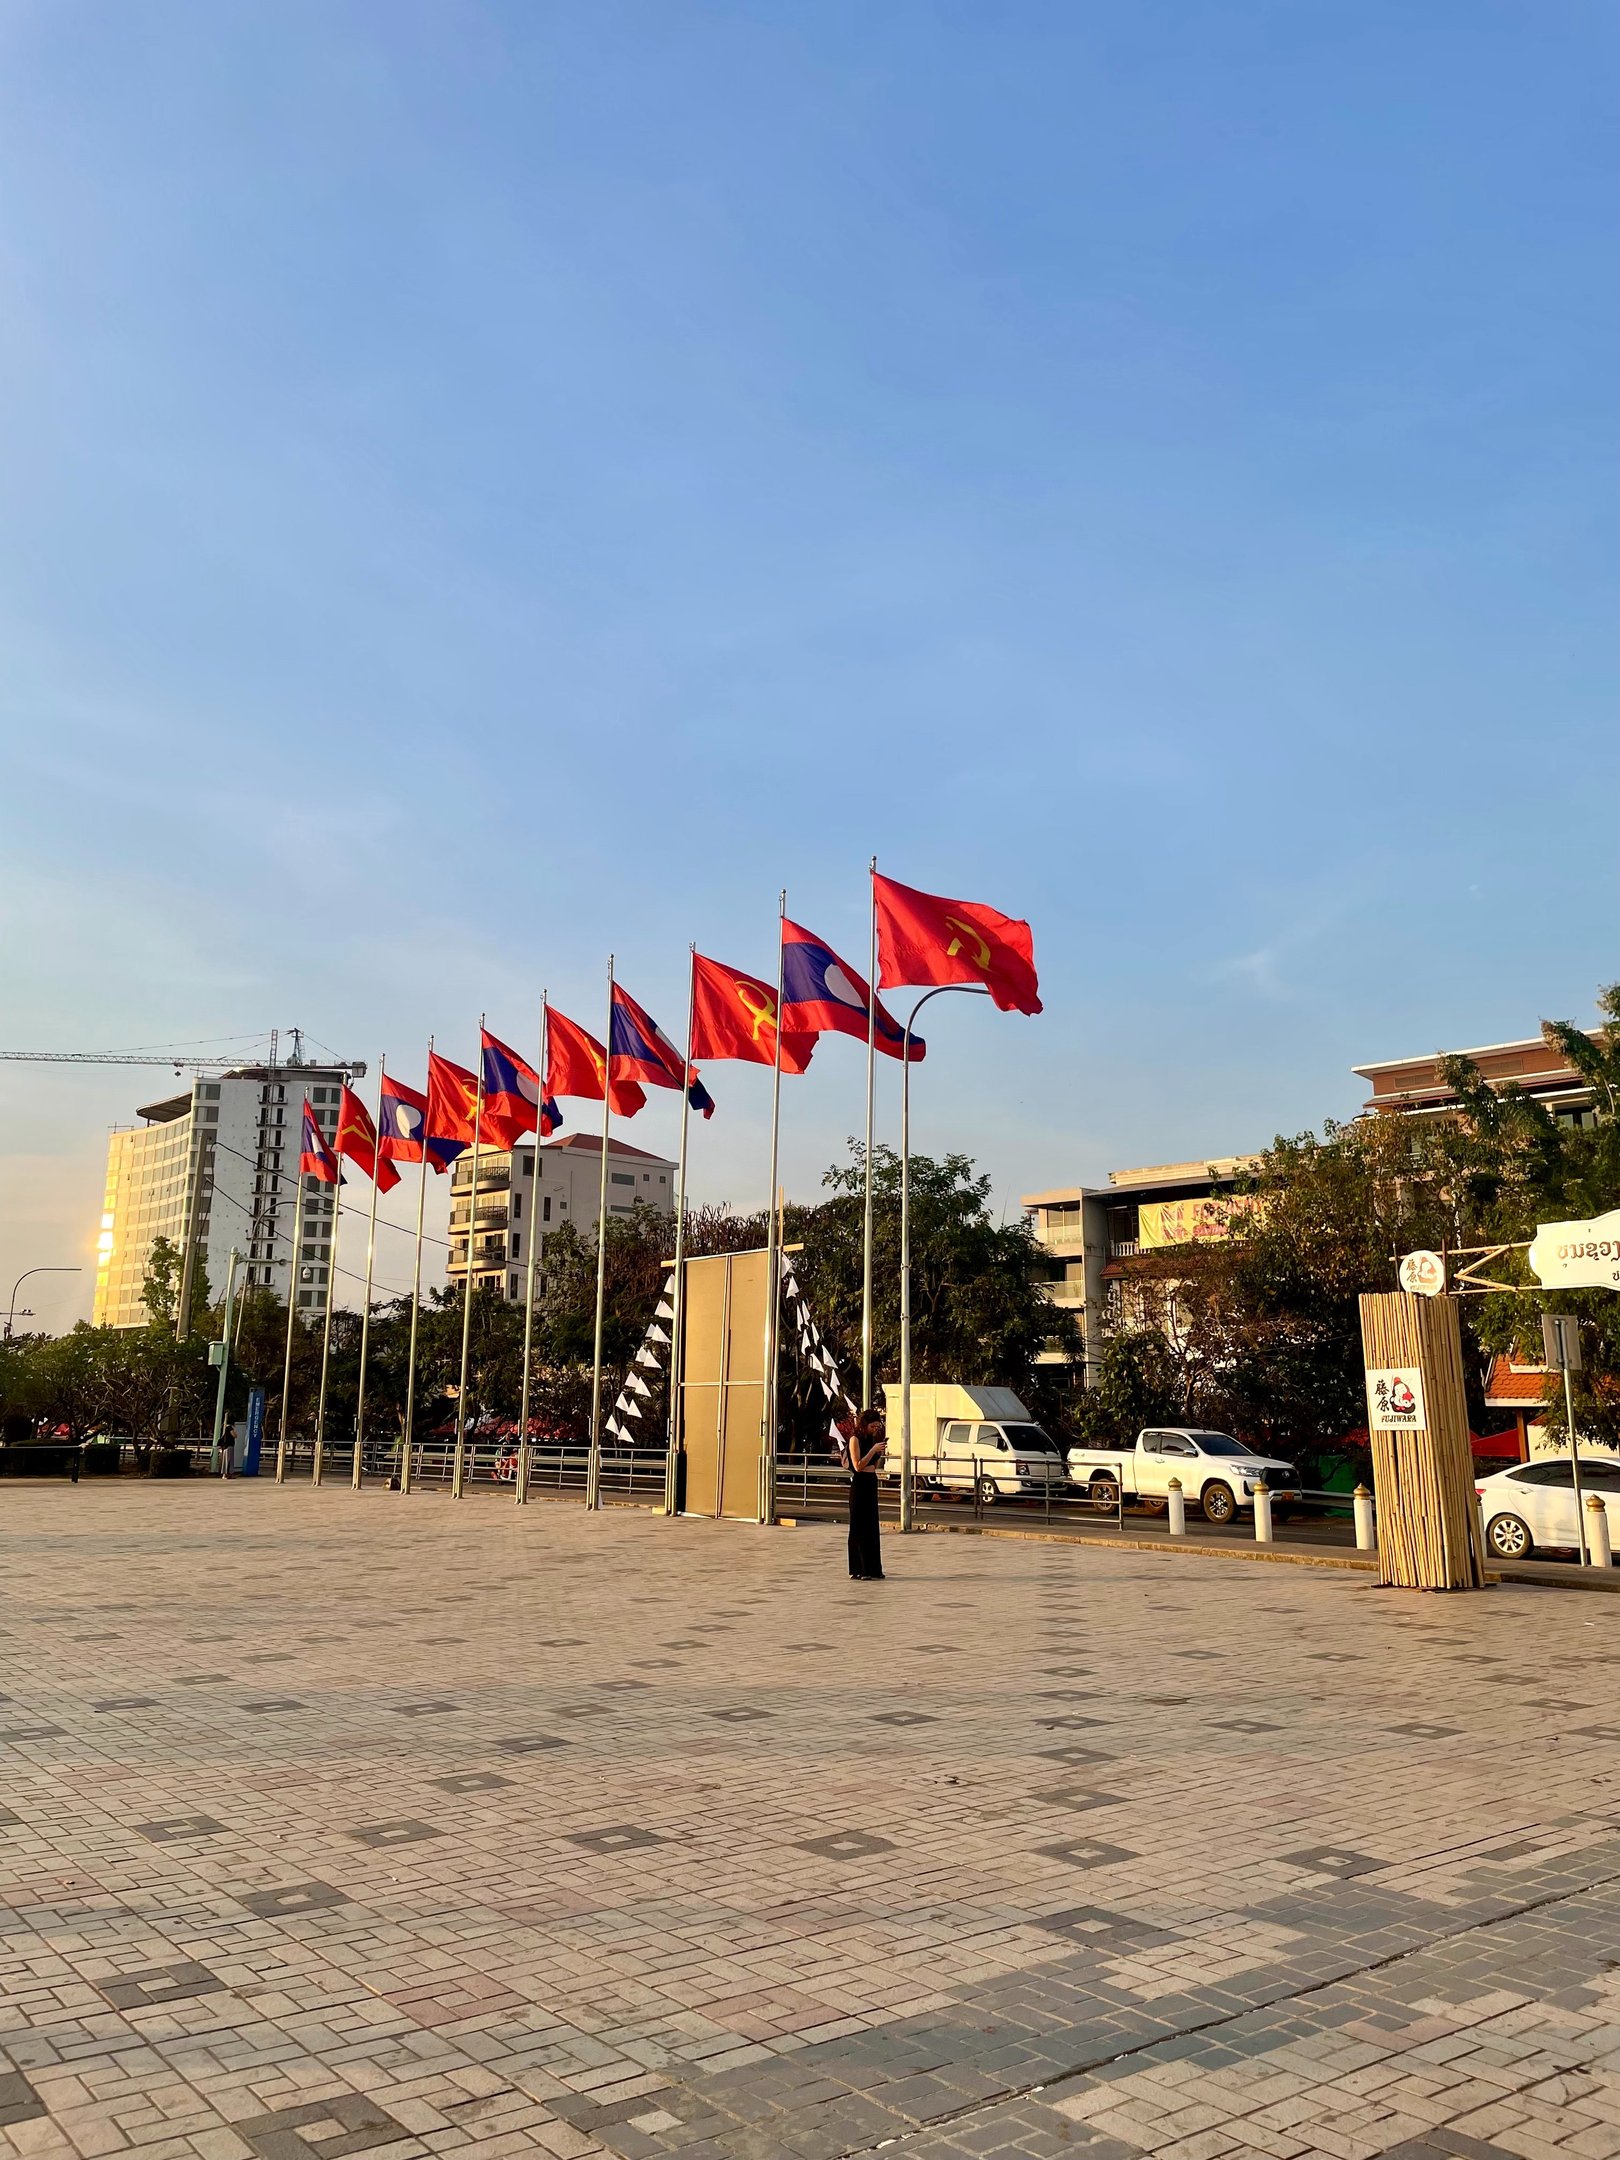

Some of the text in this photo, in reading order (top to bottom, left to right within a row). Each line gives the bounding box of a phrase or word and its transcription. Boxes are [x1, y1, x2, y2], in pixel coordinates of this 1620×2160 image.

[1375, 1379, 1390, 1412] 藤原
[253, 1397, 261, 1438] EMERGENCY
[1381, 1415, 1417, 1423] FUJIWARA
